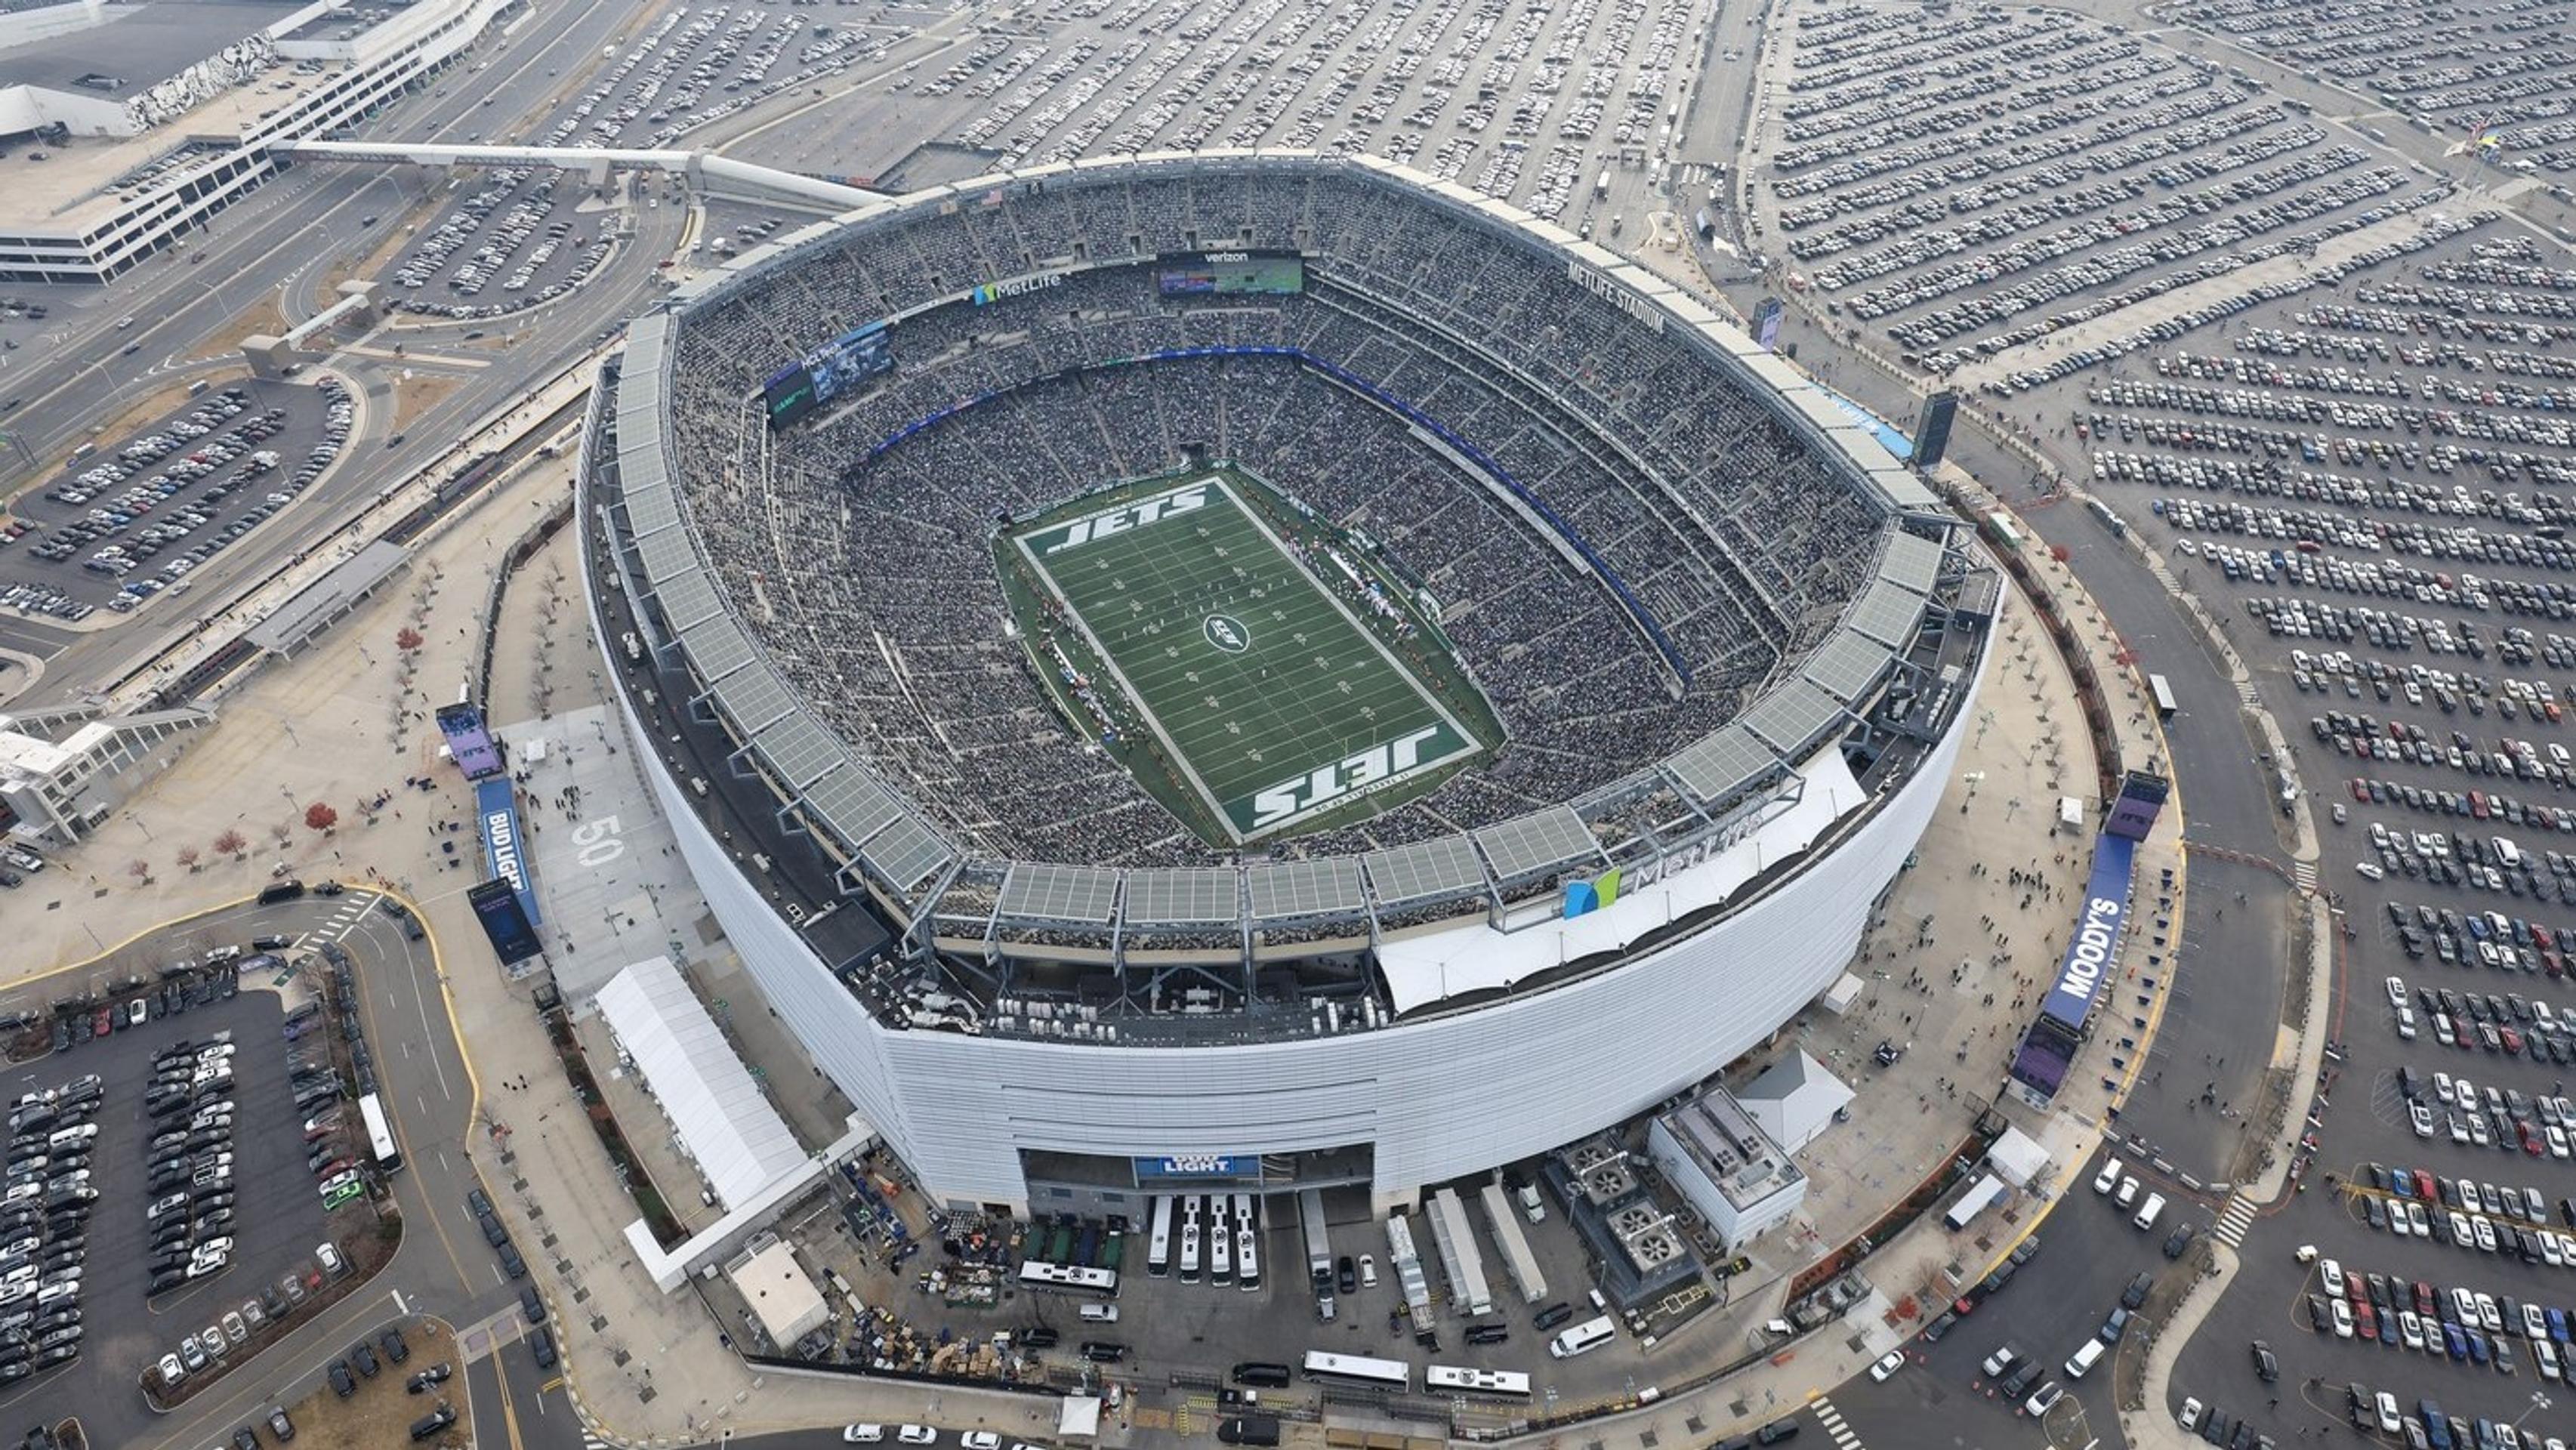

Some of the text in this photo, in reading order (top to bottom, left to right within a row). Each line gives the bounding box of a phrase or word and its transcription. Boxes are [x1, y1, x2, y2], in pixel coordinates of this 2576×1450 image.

[997, 273, 1061, 298] MetLife
[1205, 252, 1248, 263] verizon
[1568, 261, 1666, 334] METLIFE STADIUM
[1047, 486, 1206, 554] JETS
[1253, 727, 1437, 827] JETS
[489, 812, 511, 846] BUD
[572, 816, 625, 866] 50
[1633, 810, 1763, 896] MetLife
[2059, 898, 2118, 999] MOODY'S
[1165, 1161, 1228, 1171] LIGHT
